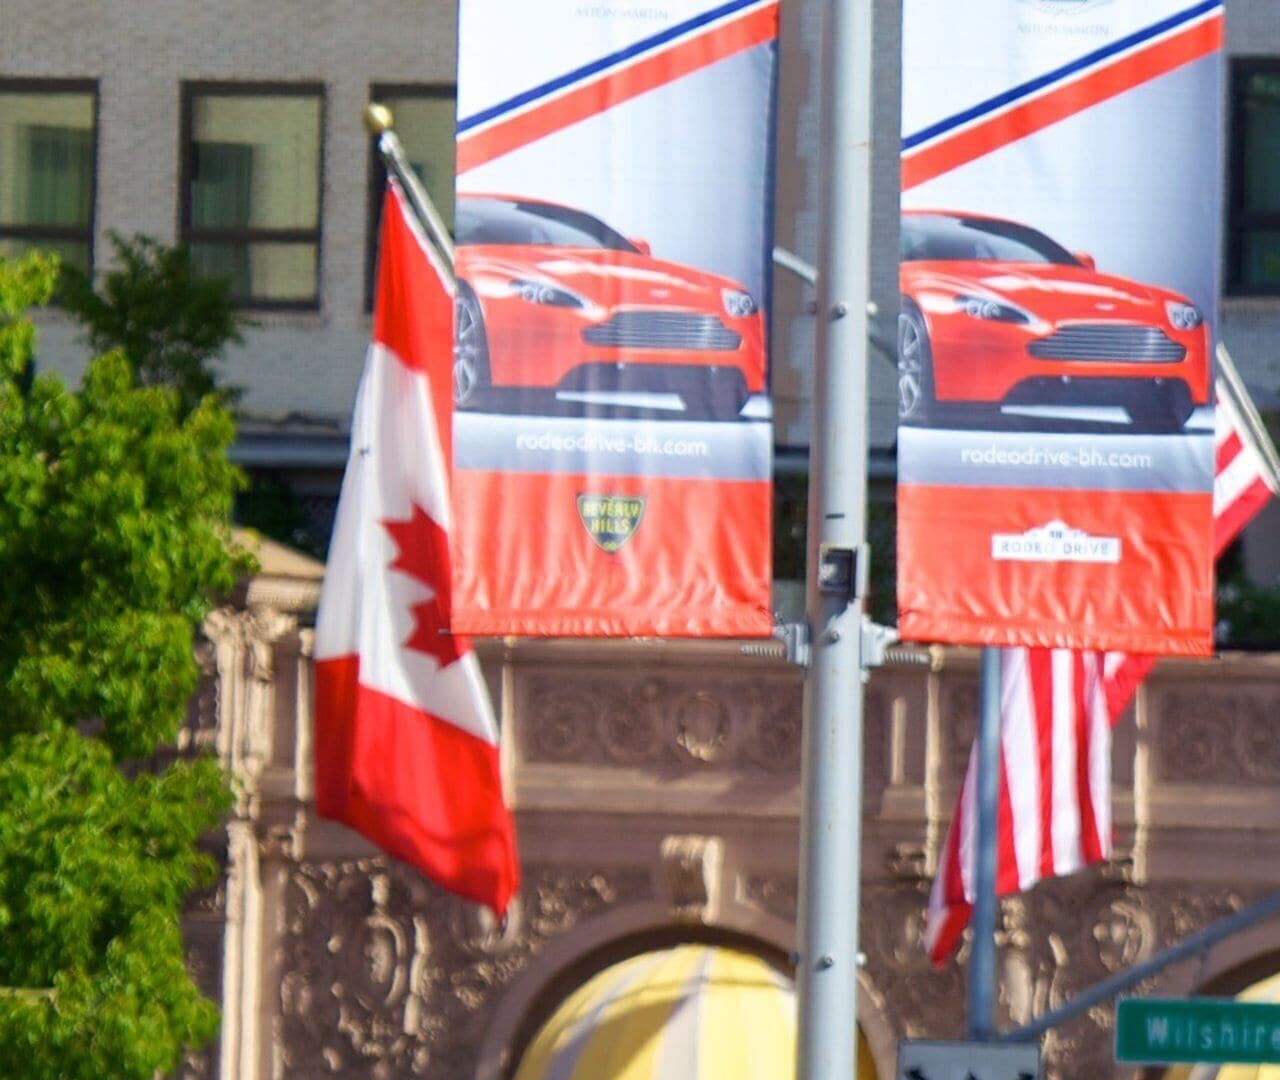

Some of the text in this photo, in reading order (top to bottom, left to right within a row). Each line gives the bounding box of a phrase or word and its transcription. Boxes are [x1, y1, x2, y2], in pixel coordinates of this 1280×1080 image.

[961, 444, 1152, 468] rodeodrive-bh.com
[583, 502, 639, 516] BEVERLY
[592, 518, 629, 534] HILLS
